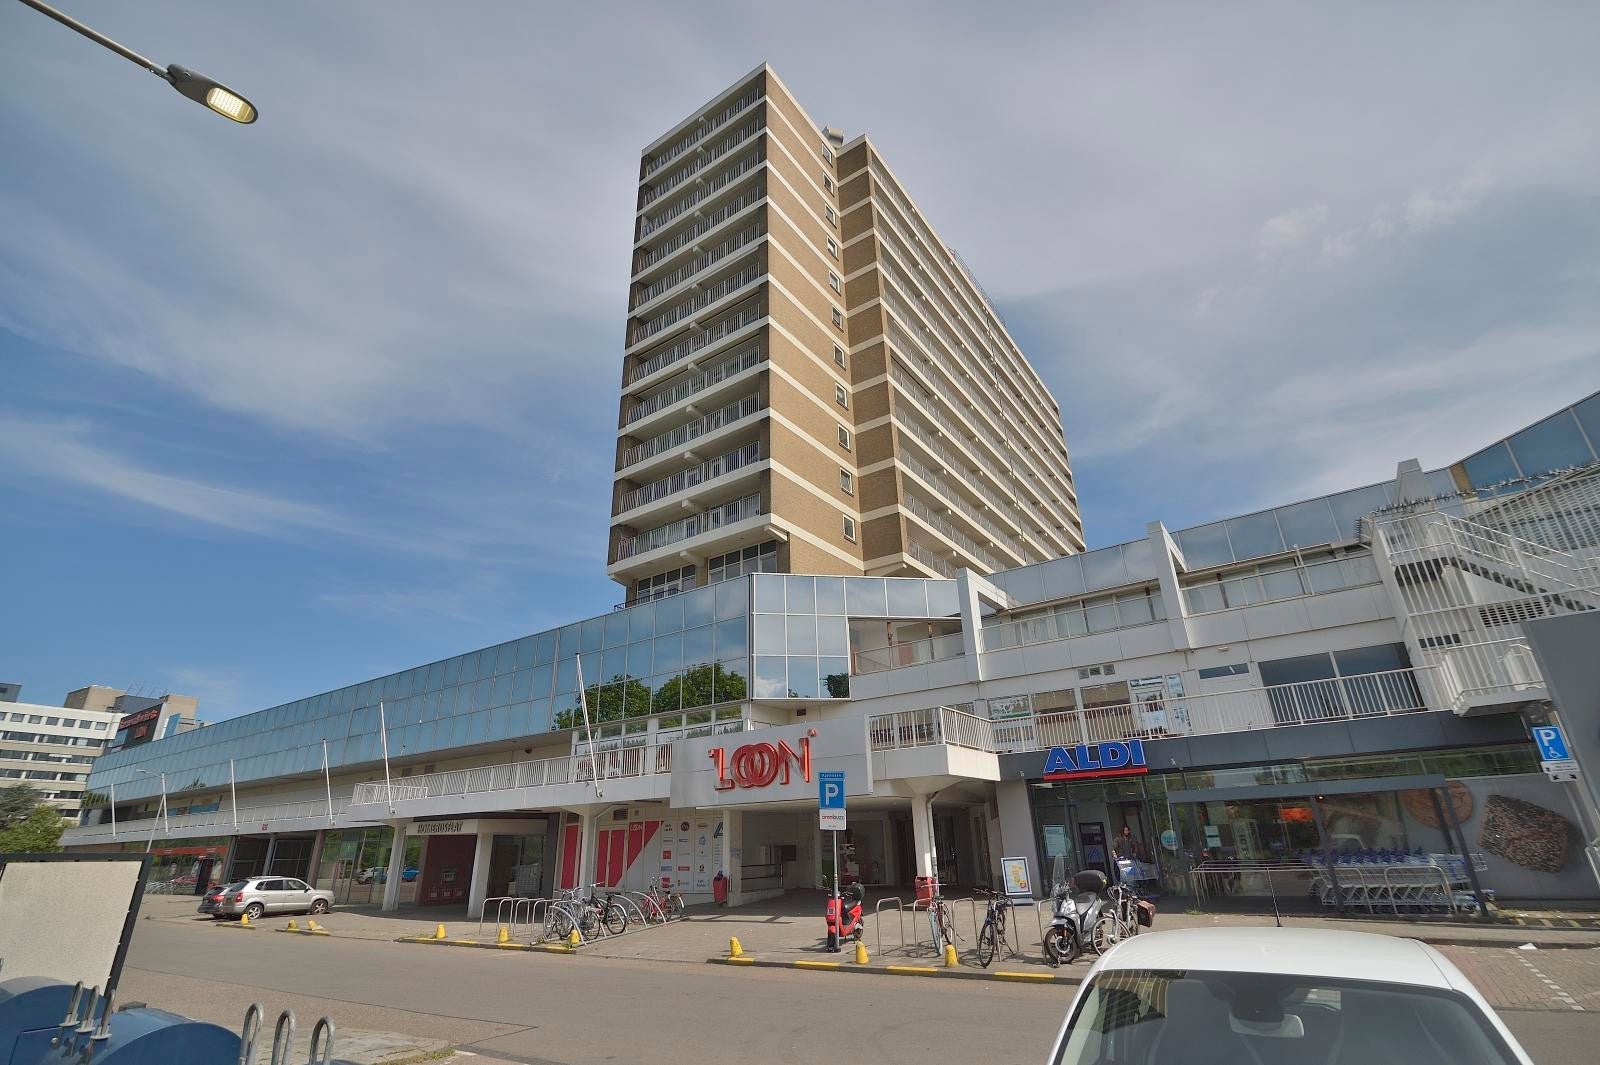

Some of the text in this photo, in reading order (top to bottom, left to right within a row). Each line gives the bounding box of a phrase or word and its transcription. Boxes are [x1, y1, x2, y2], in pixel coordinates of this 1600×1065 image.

[1043, 739, 1146, 773] ALDI
[825, 783, 839, 805] P
[416, 820, 464, 834] HOMERUSFLAT
